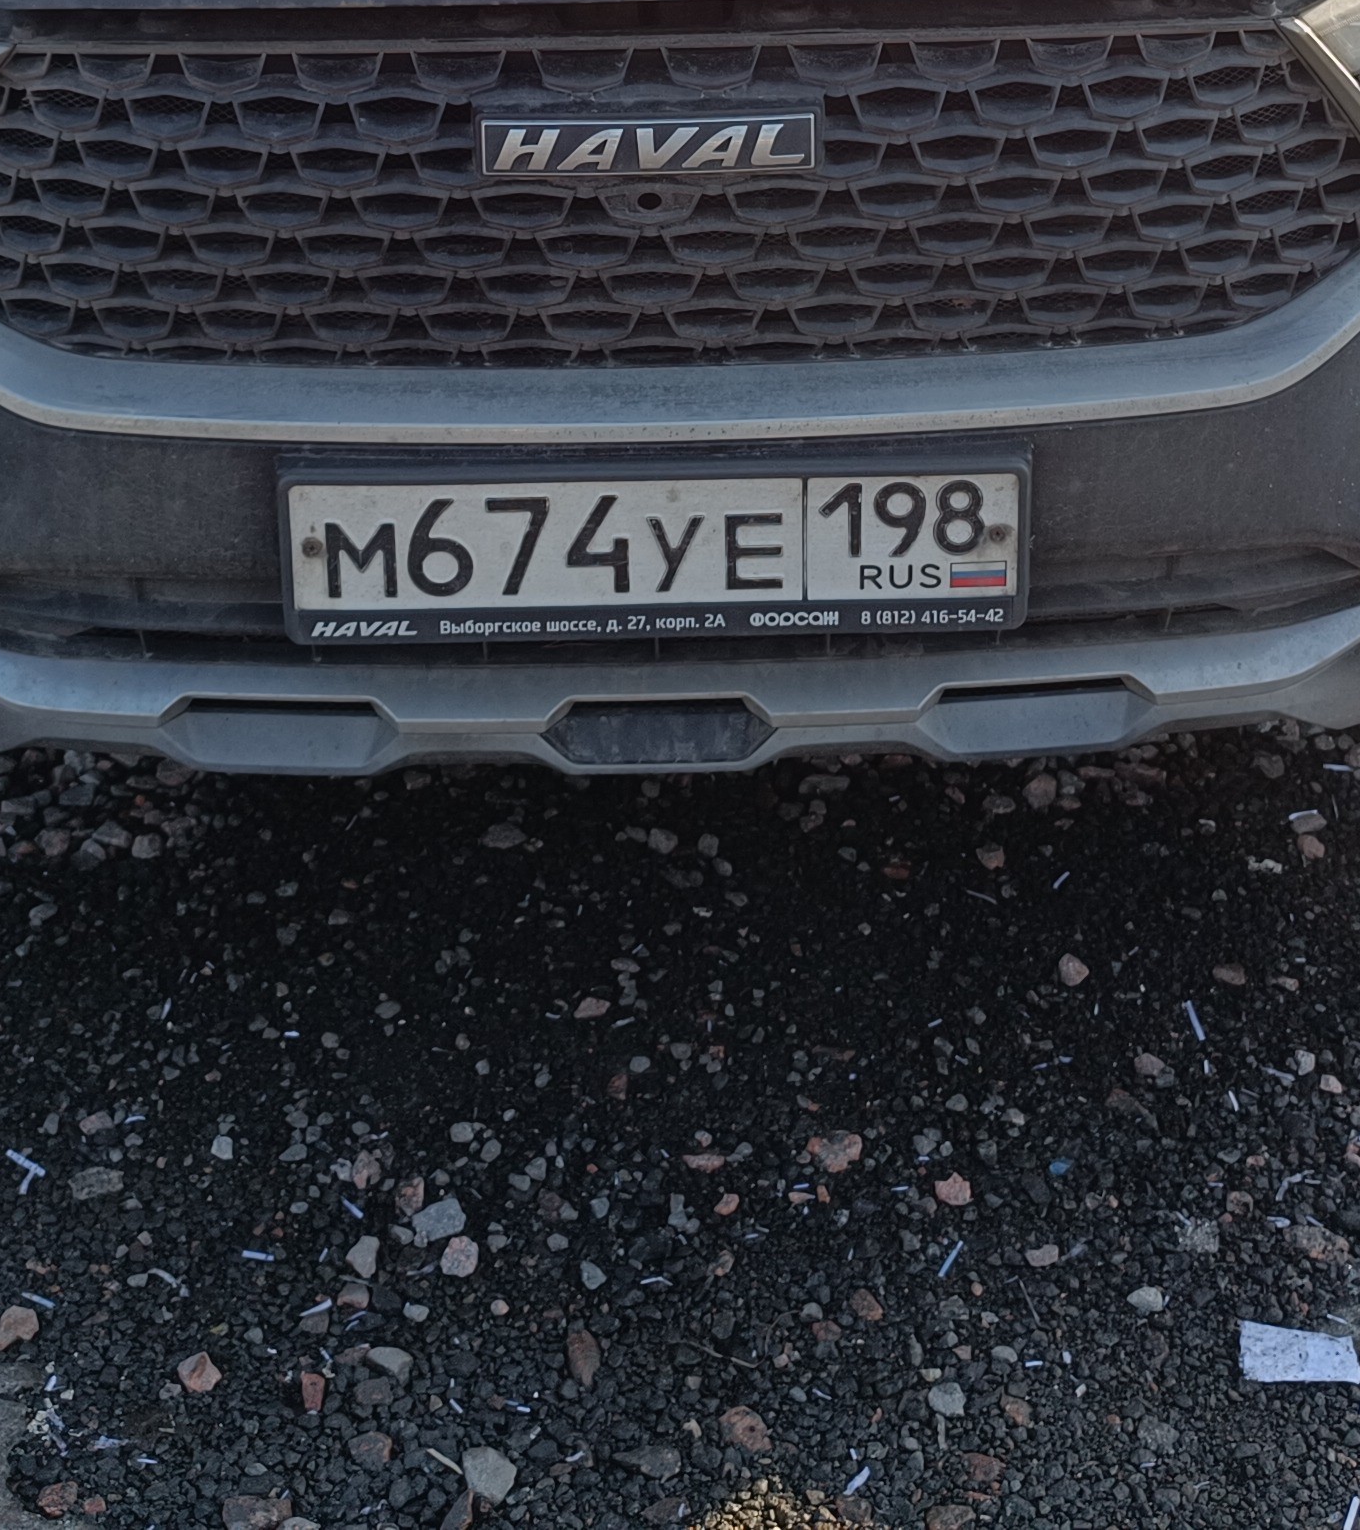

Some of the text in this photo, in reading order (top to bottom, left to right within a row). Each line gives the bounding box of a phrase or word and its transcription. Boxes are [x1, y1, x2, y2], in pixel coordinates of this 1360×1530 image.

[493, 123, 805, 171] HAVAL
[325, 480, 985, 598] М674УЕ 198
[858, 563, 942, 590] RUS
[311, 620, 418, 637] HAVAL
[440, 619, 541, 635] Выборгское
[546, 619, 602, 633] шоссе,
[606, 619, 623, 633] д.
[627, 616, 651, 632] 27,
[655, 616, 699, 630] корп.
[860, 608, 1004, 626] 8 (812) 416-54-42
